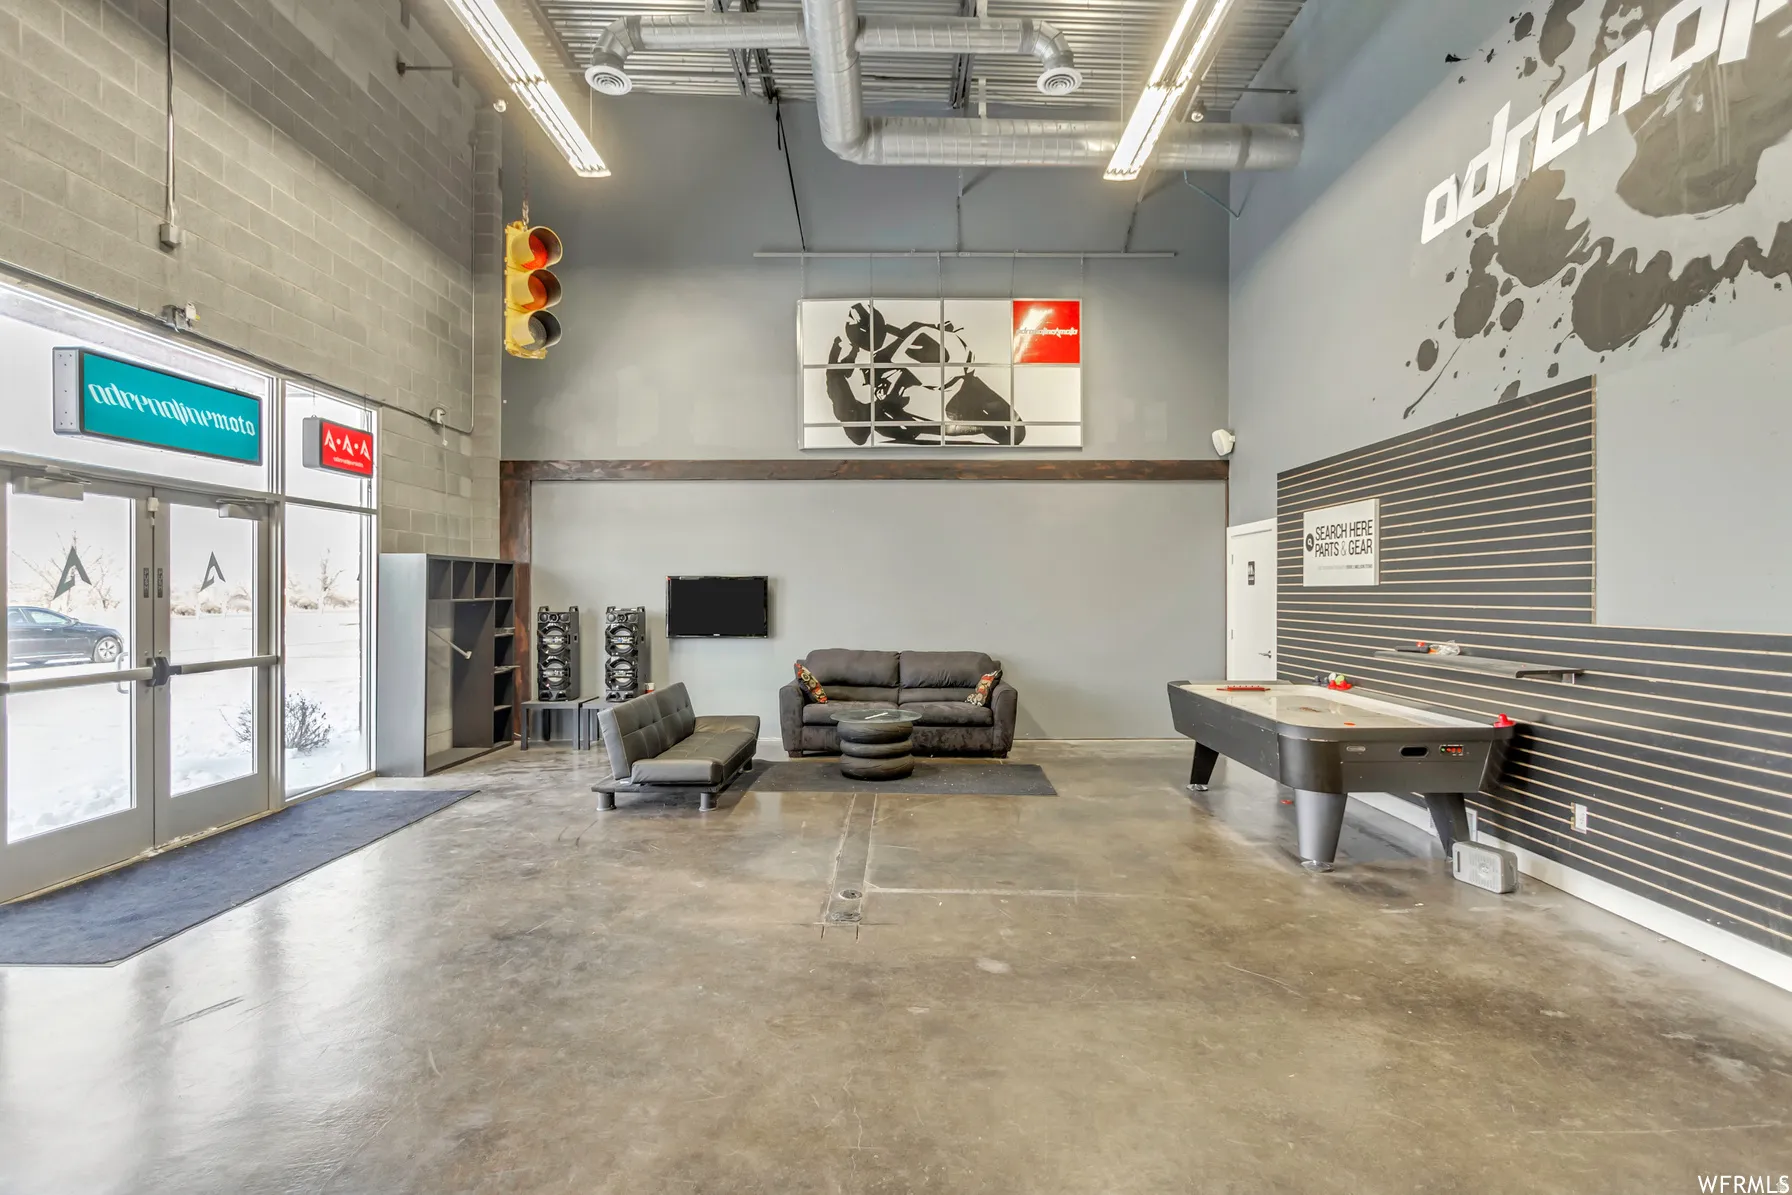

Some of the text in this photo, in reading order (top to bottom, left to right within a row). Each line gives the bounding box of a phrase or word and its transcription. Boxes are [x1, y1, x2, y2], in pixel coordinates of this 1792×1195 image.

[1315, 519, 1374, 541] SEARCH HERE
[1314, 538, 1374, 558] PARTS & GEAR
